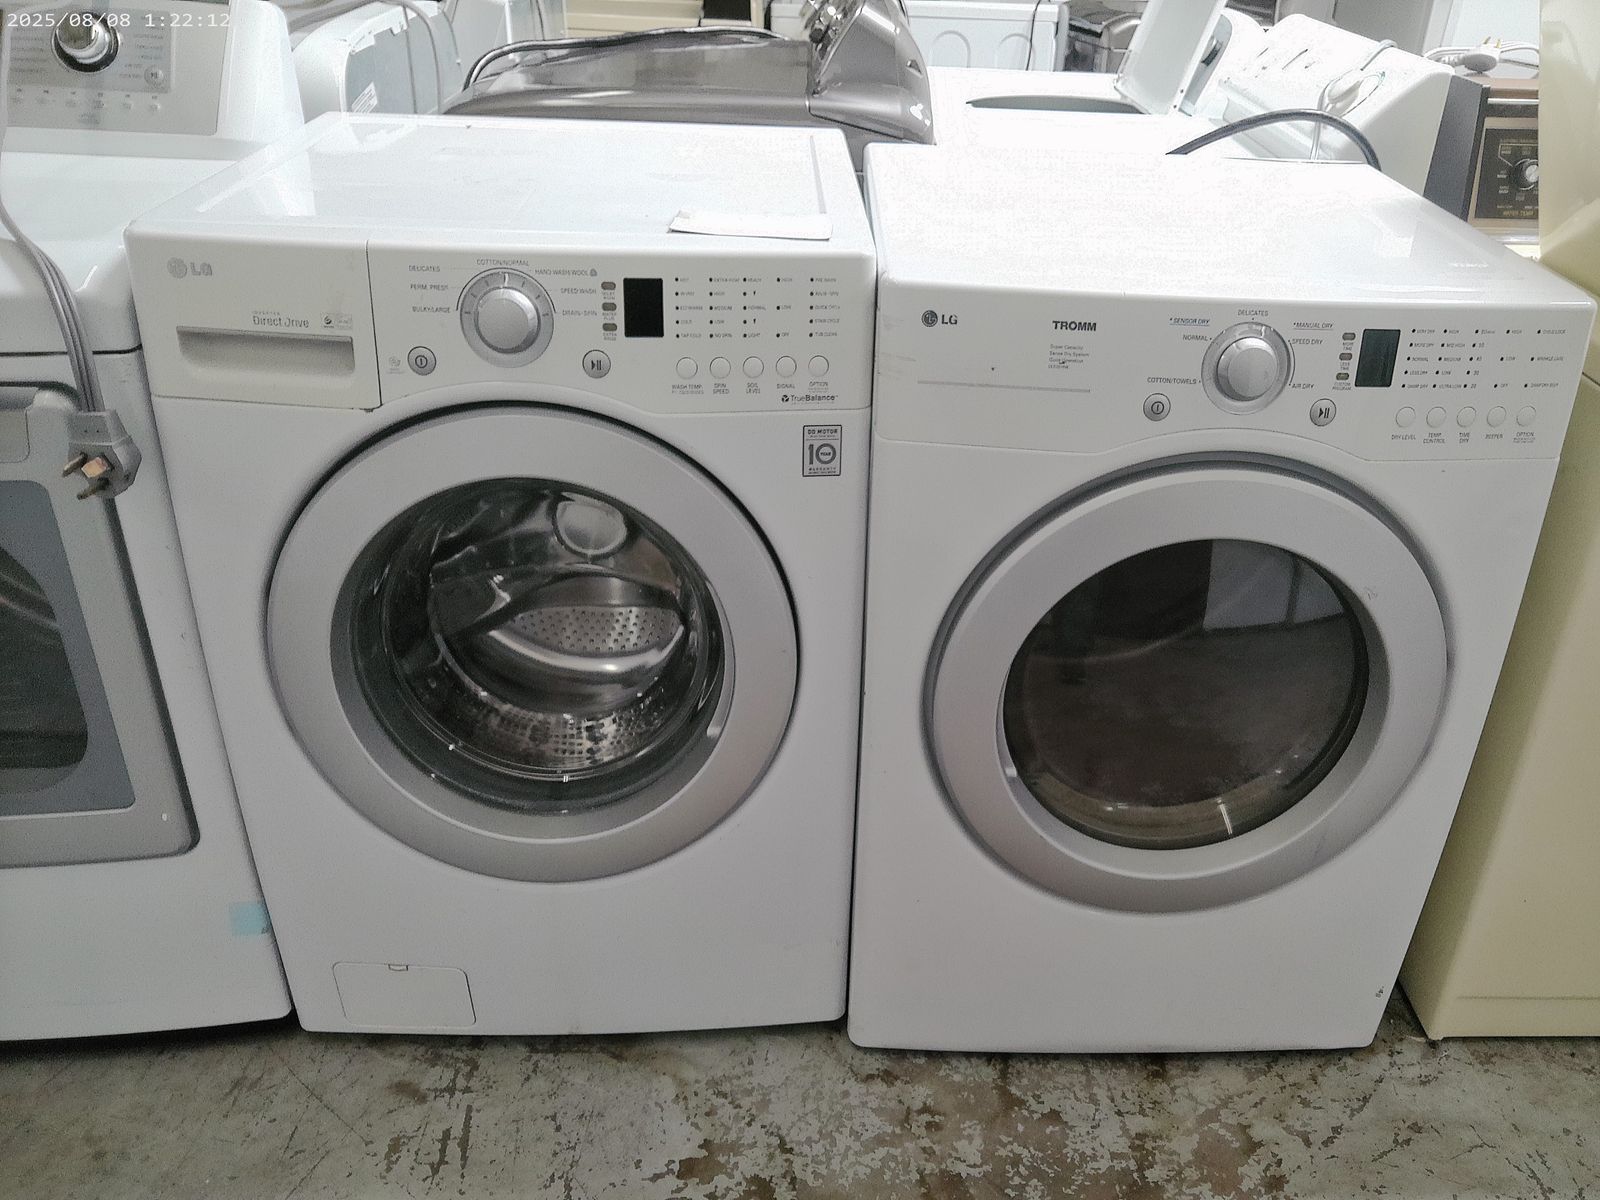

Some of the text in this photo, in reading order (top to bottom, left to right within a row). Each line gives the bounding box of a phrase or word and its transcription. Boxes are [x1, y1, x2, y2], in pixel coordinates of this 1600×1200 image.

[1237, 309, 1270, 317] DELICATES
[252, 315, 282, 326] Direct
[941, 314, 958, 325] LG
[1052, 320, 1097, 331] TROMM
[1182, 334, 1208, 342] NORMAL
[1147, 376, 1197, 385] COTTON/TOWELS
